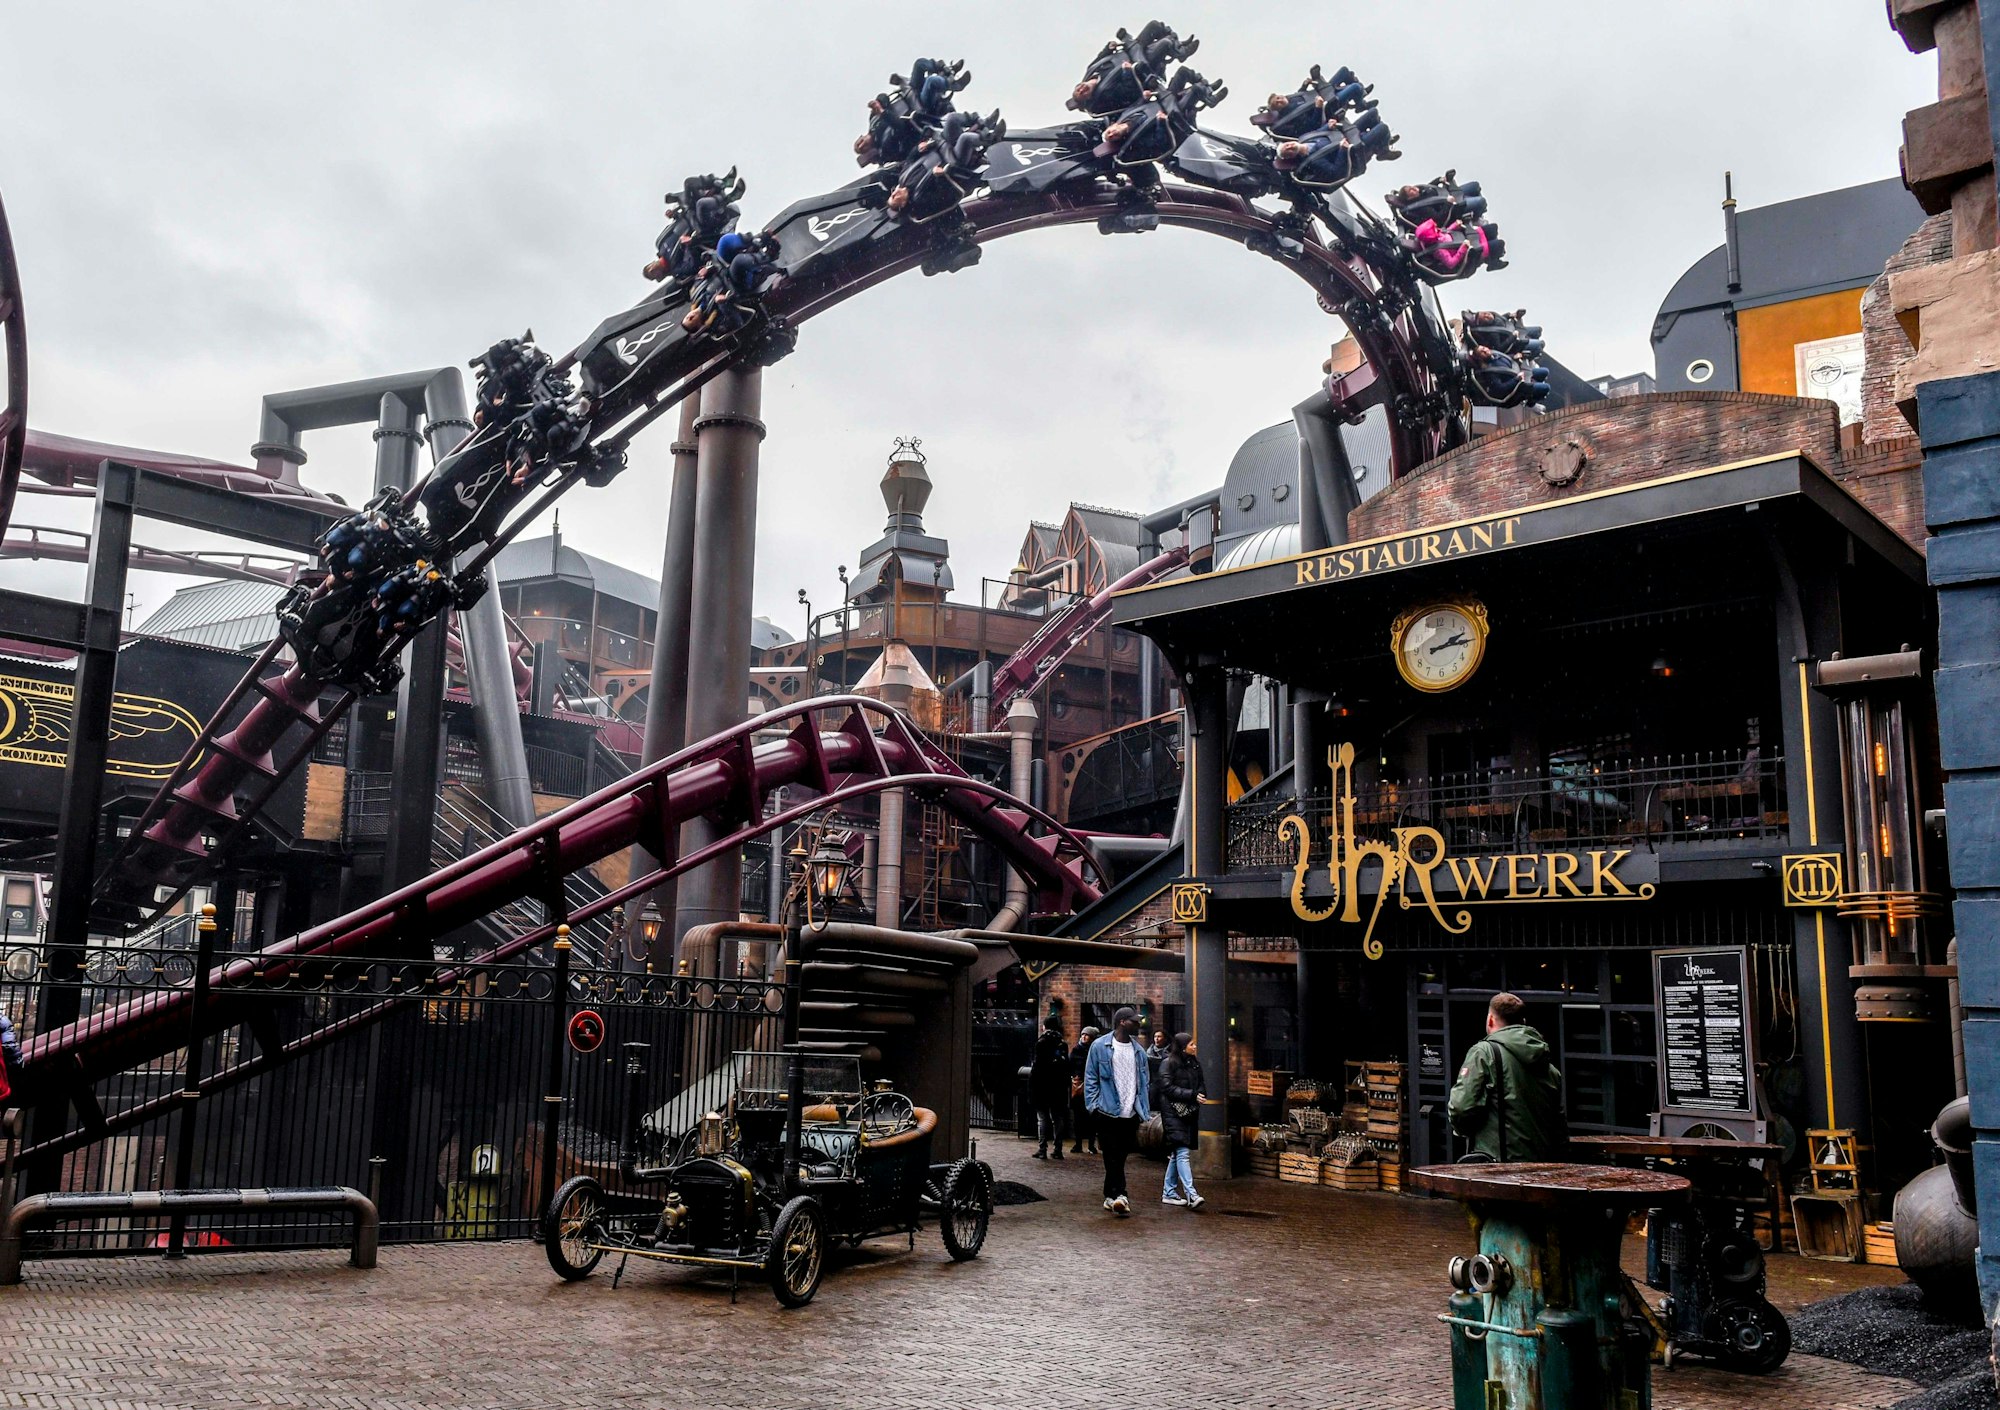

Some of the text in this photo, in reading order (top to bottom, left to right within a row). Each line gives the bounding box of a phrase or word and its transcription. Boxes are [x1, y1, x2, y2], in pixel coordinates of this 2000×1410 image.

[1294, 516, 1521, 586] RESTAURANT
[1436, 617, 1444, 627] 12
[1413, 647, 1419, 656] 9
[1459, 652, 1465, 661] 4
[1417, 659, 1423, 668] 8
[1452, 663, 1458, 672] 5
[1426, 667, 1431, 676] 7
[1439, 668, 1445, 677] 6
[0, 748, 65, 765] COMPAN
[1795, 863, 1831, 896] III
[1179, 890, 1200, 916] IX
